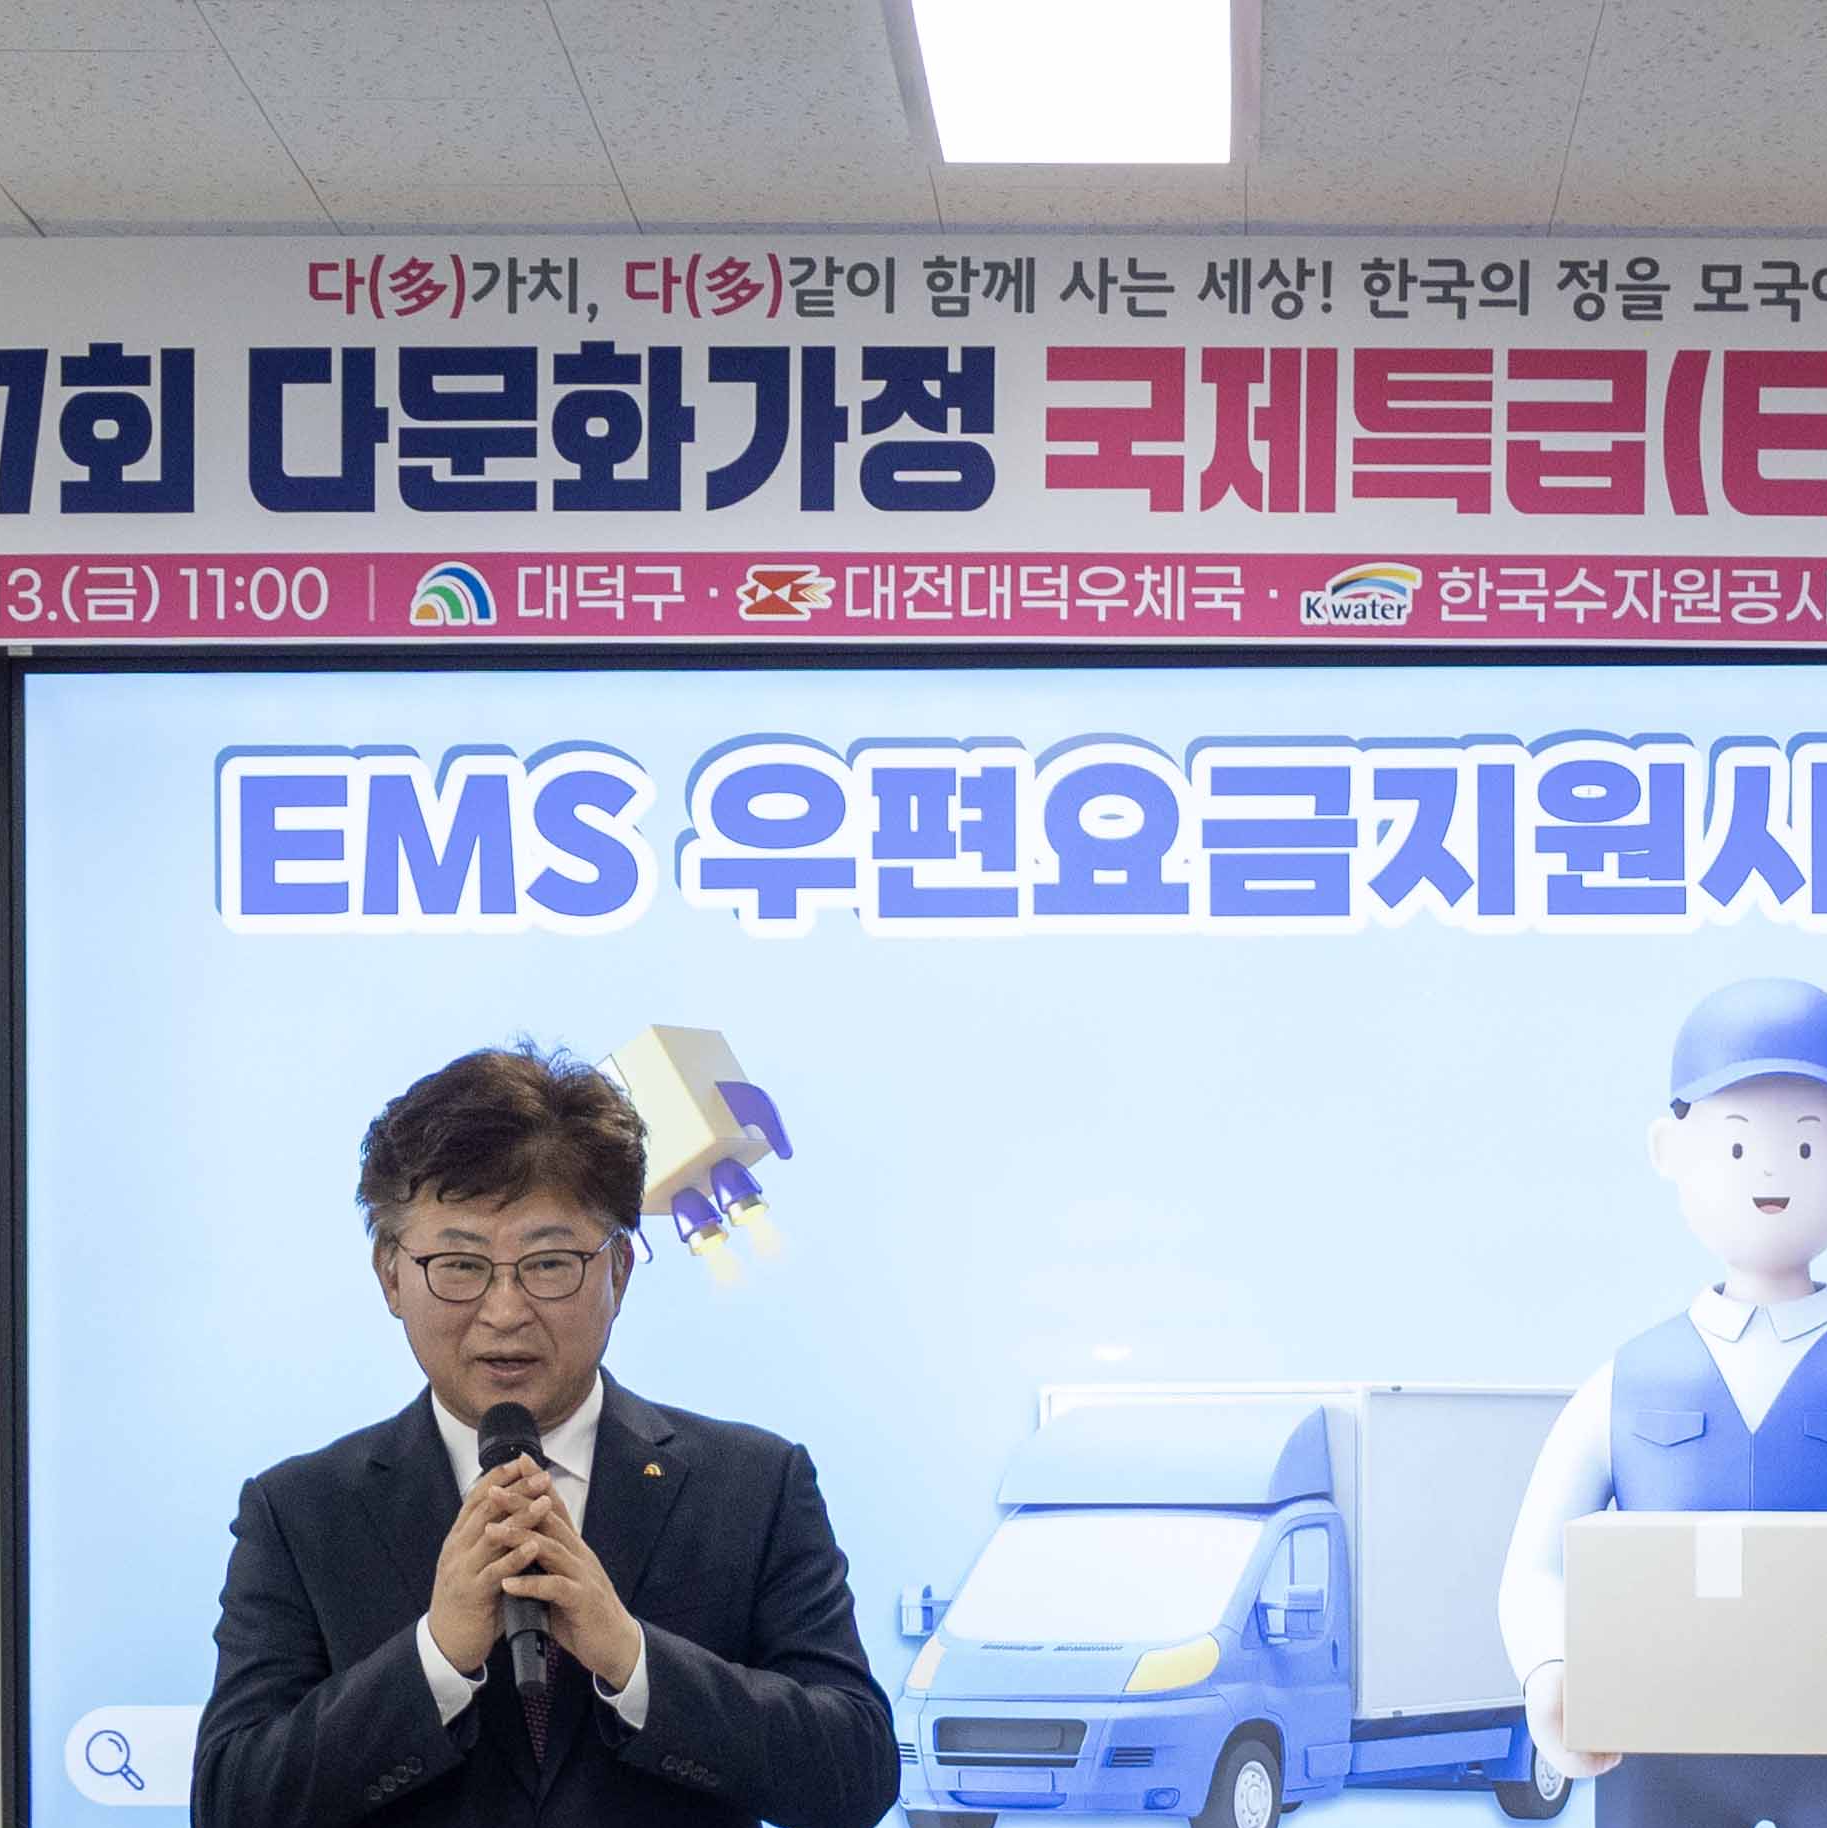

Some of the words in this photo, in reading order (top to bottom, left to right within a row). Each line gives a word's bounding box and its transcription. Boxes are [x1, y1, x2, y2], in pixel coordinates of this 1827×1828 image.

[308, 255, 599, 321] 다(多)가치,
[625, 255, 896, 318] 다(多)같이
[923, 255, 1035, 319] 함께
[1059, 257, 1175, 318] 사는
[1198, 258, 1333, 319] 세상!
[1361, 257, 1532, 320] 한국의
[1556, 257, 1671, 321] 정을
[247, 340, 996, 513] 다문화가정
[180, 566, 328, 622] 11:00
[519, 564, 684, 623] 대덕구
[846, 563, 1245, 624] 대전대덕우체국
[236, 764, 644, 920] EMS
